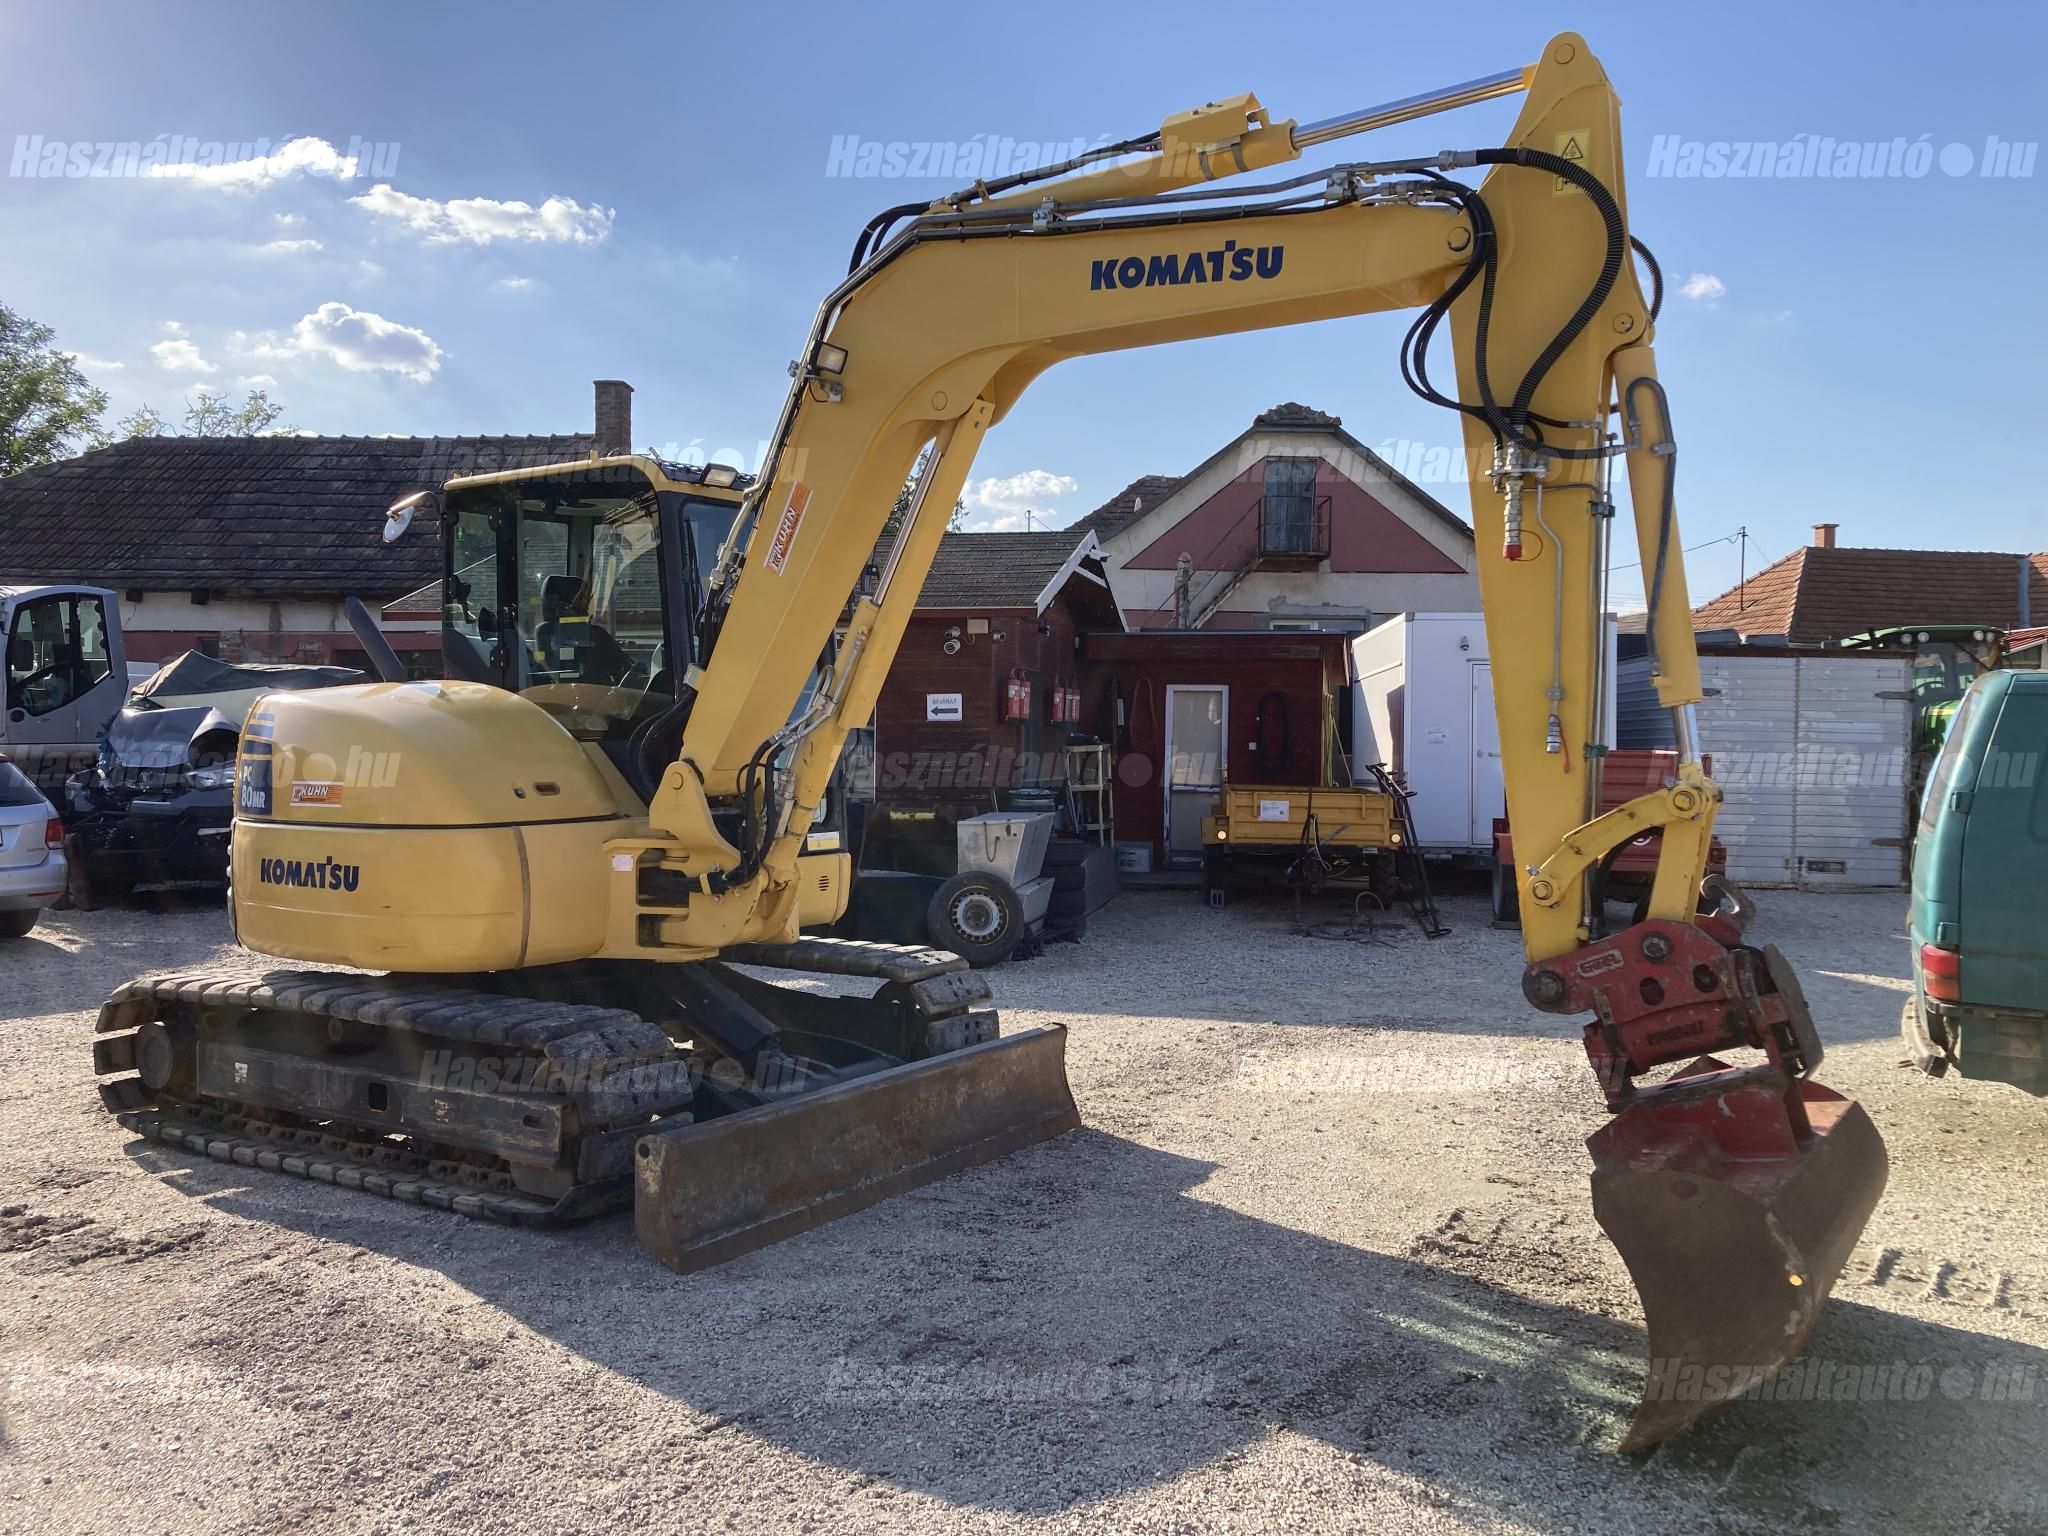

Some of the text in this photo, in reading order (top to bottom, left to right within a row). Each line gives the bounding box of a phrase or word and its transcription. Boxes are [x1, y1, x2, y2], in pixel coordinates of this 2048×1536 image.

[1091, 240, 1284, 290] KOMATSU
[773, 505, 797, 558] KUHN
[242, 765, 253, 781] PC
[300, 785, 329, 797] KUHN
[261, 856, 359, 892] KOMATSU
